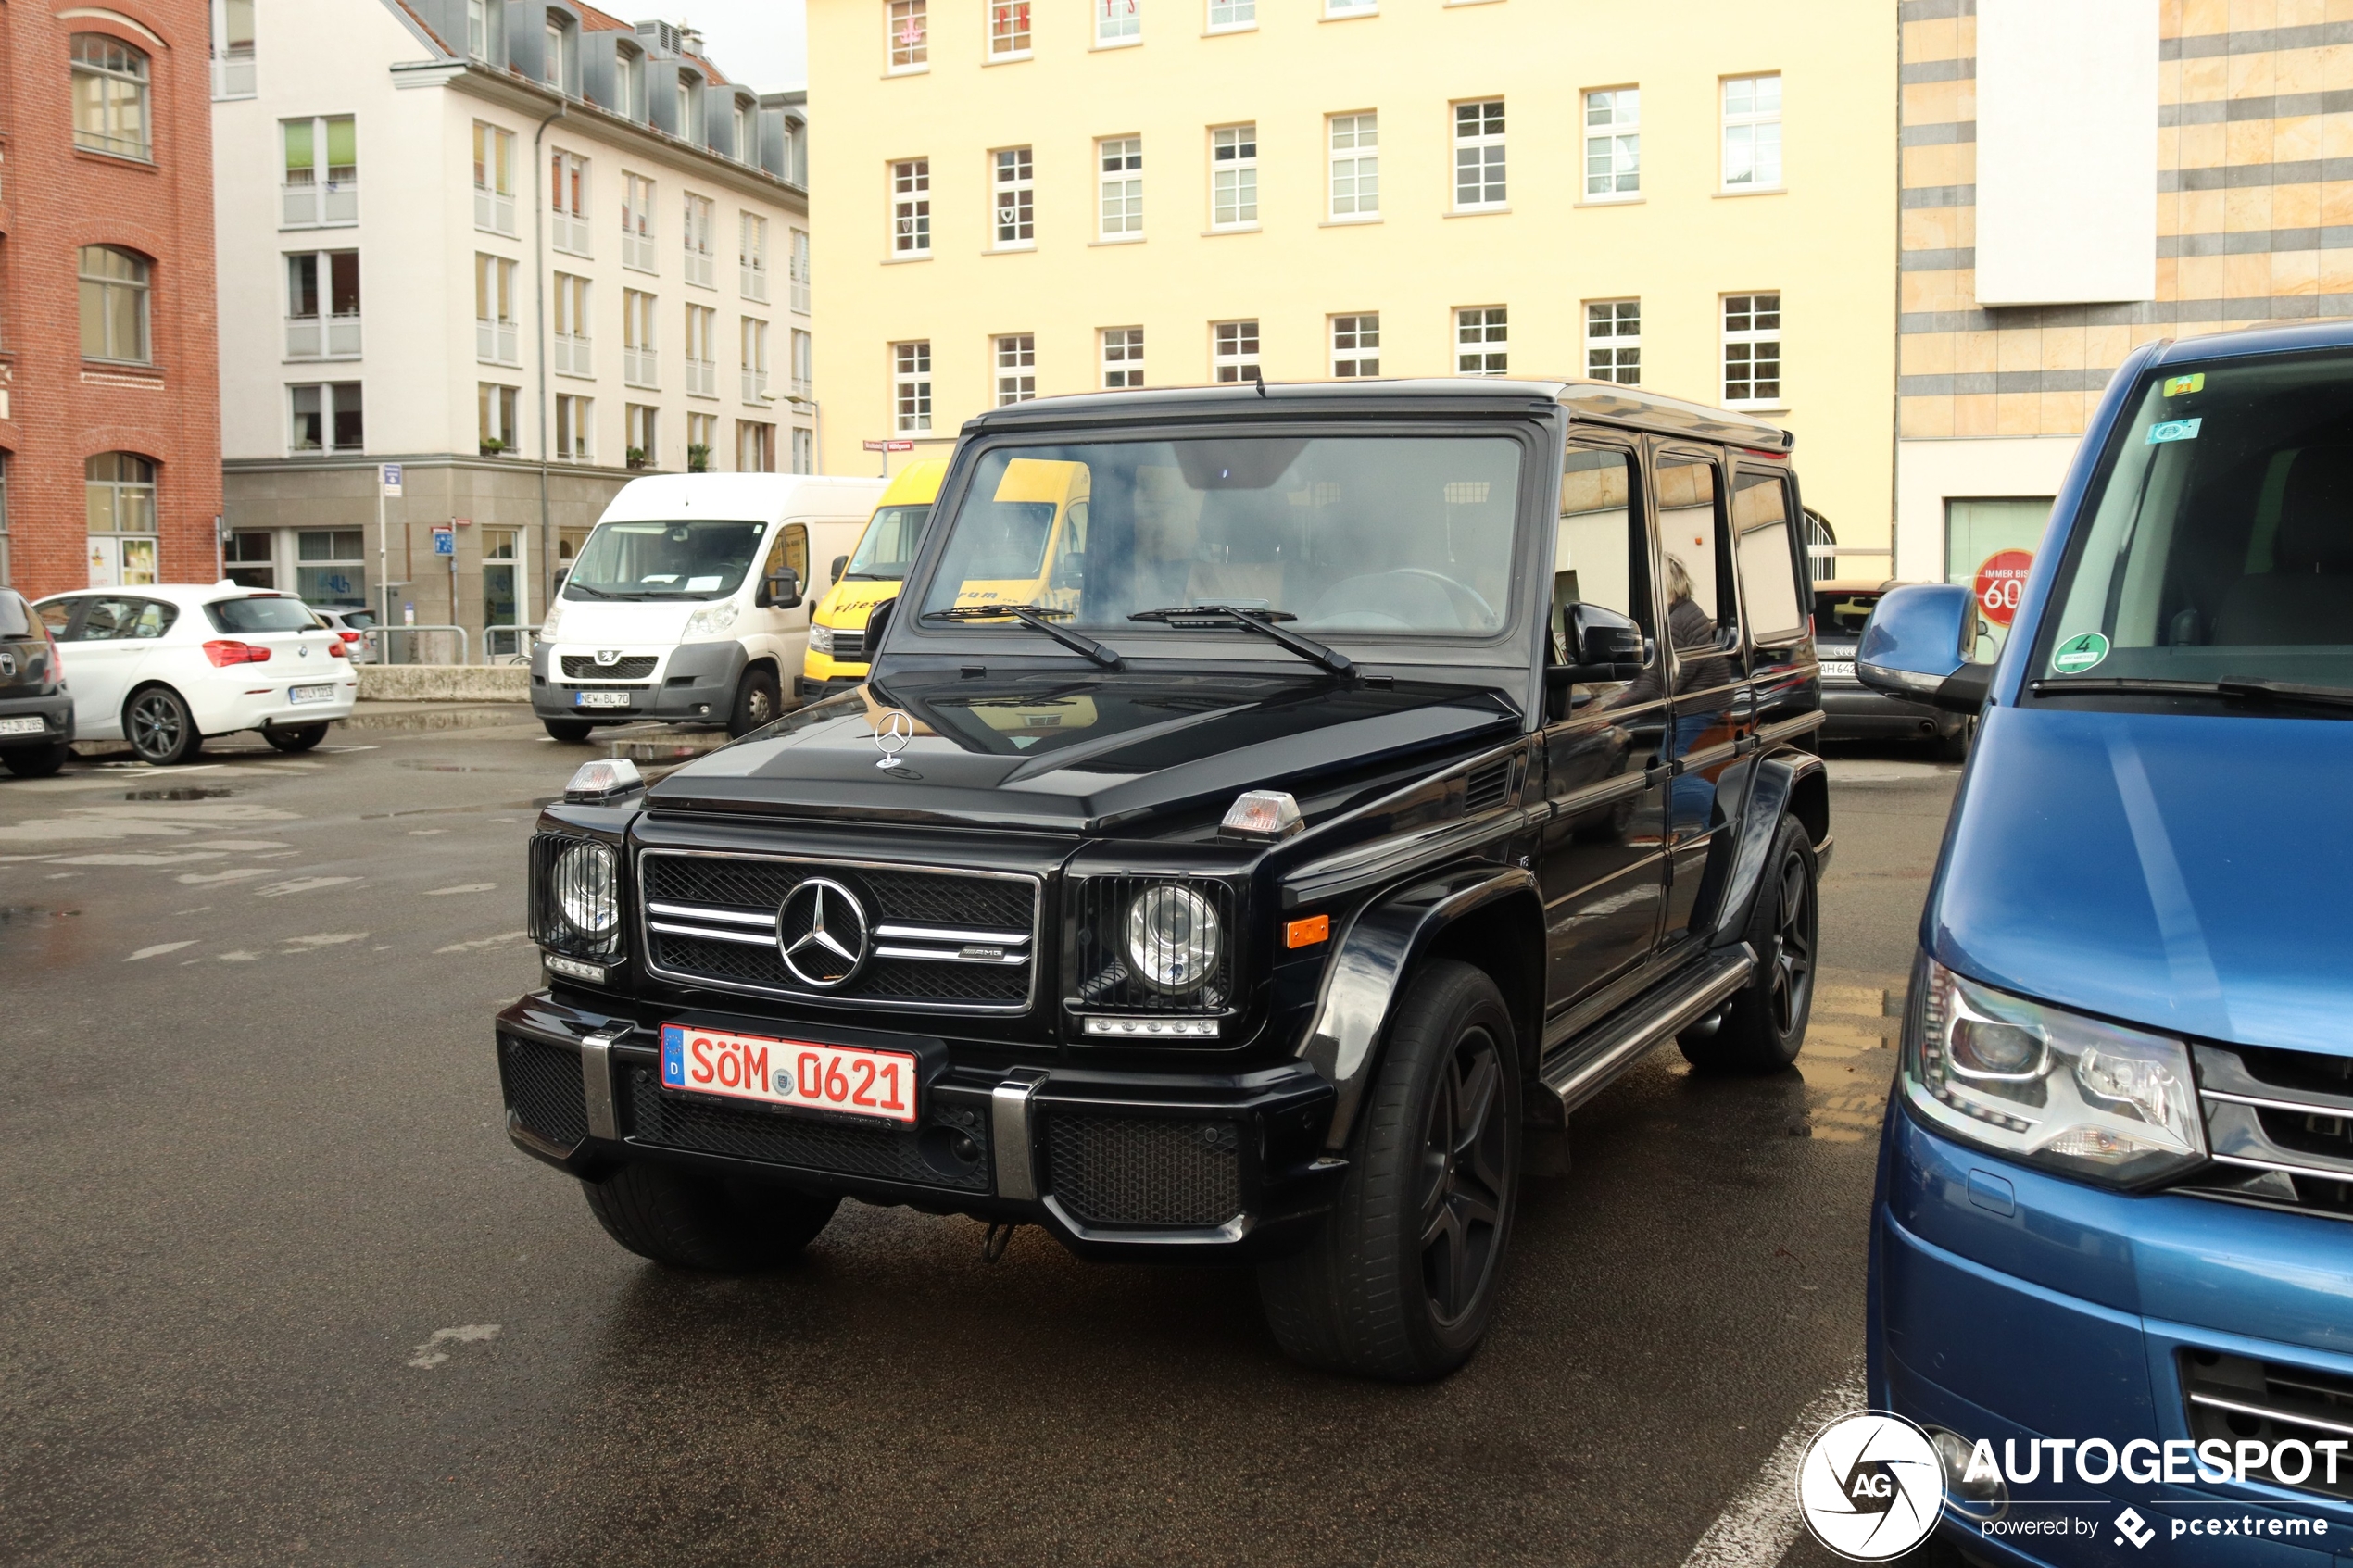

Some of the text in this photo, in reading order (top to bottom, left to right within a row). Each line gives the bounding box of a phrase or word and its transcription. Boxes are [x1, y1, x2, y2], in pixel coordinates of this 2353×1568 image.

[2175, 383, 2192, 393] 21
[1985, 569, 2030, 578] IMMER BIS
[1983, 579, 2023, 609] 60
[2075, 635, 2091, 652] 4
[1820, 664, 1856, 674] AH 642
[582, 694, 629, 704] NEW BL 70
[27, 719, 44, 731] 285
[670, 1061, 679, 1075] D
[691, 1037, 905, 1110] SÖM 0621
